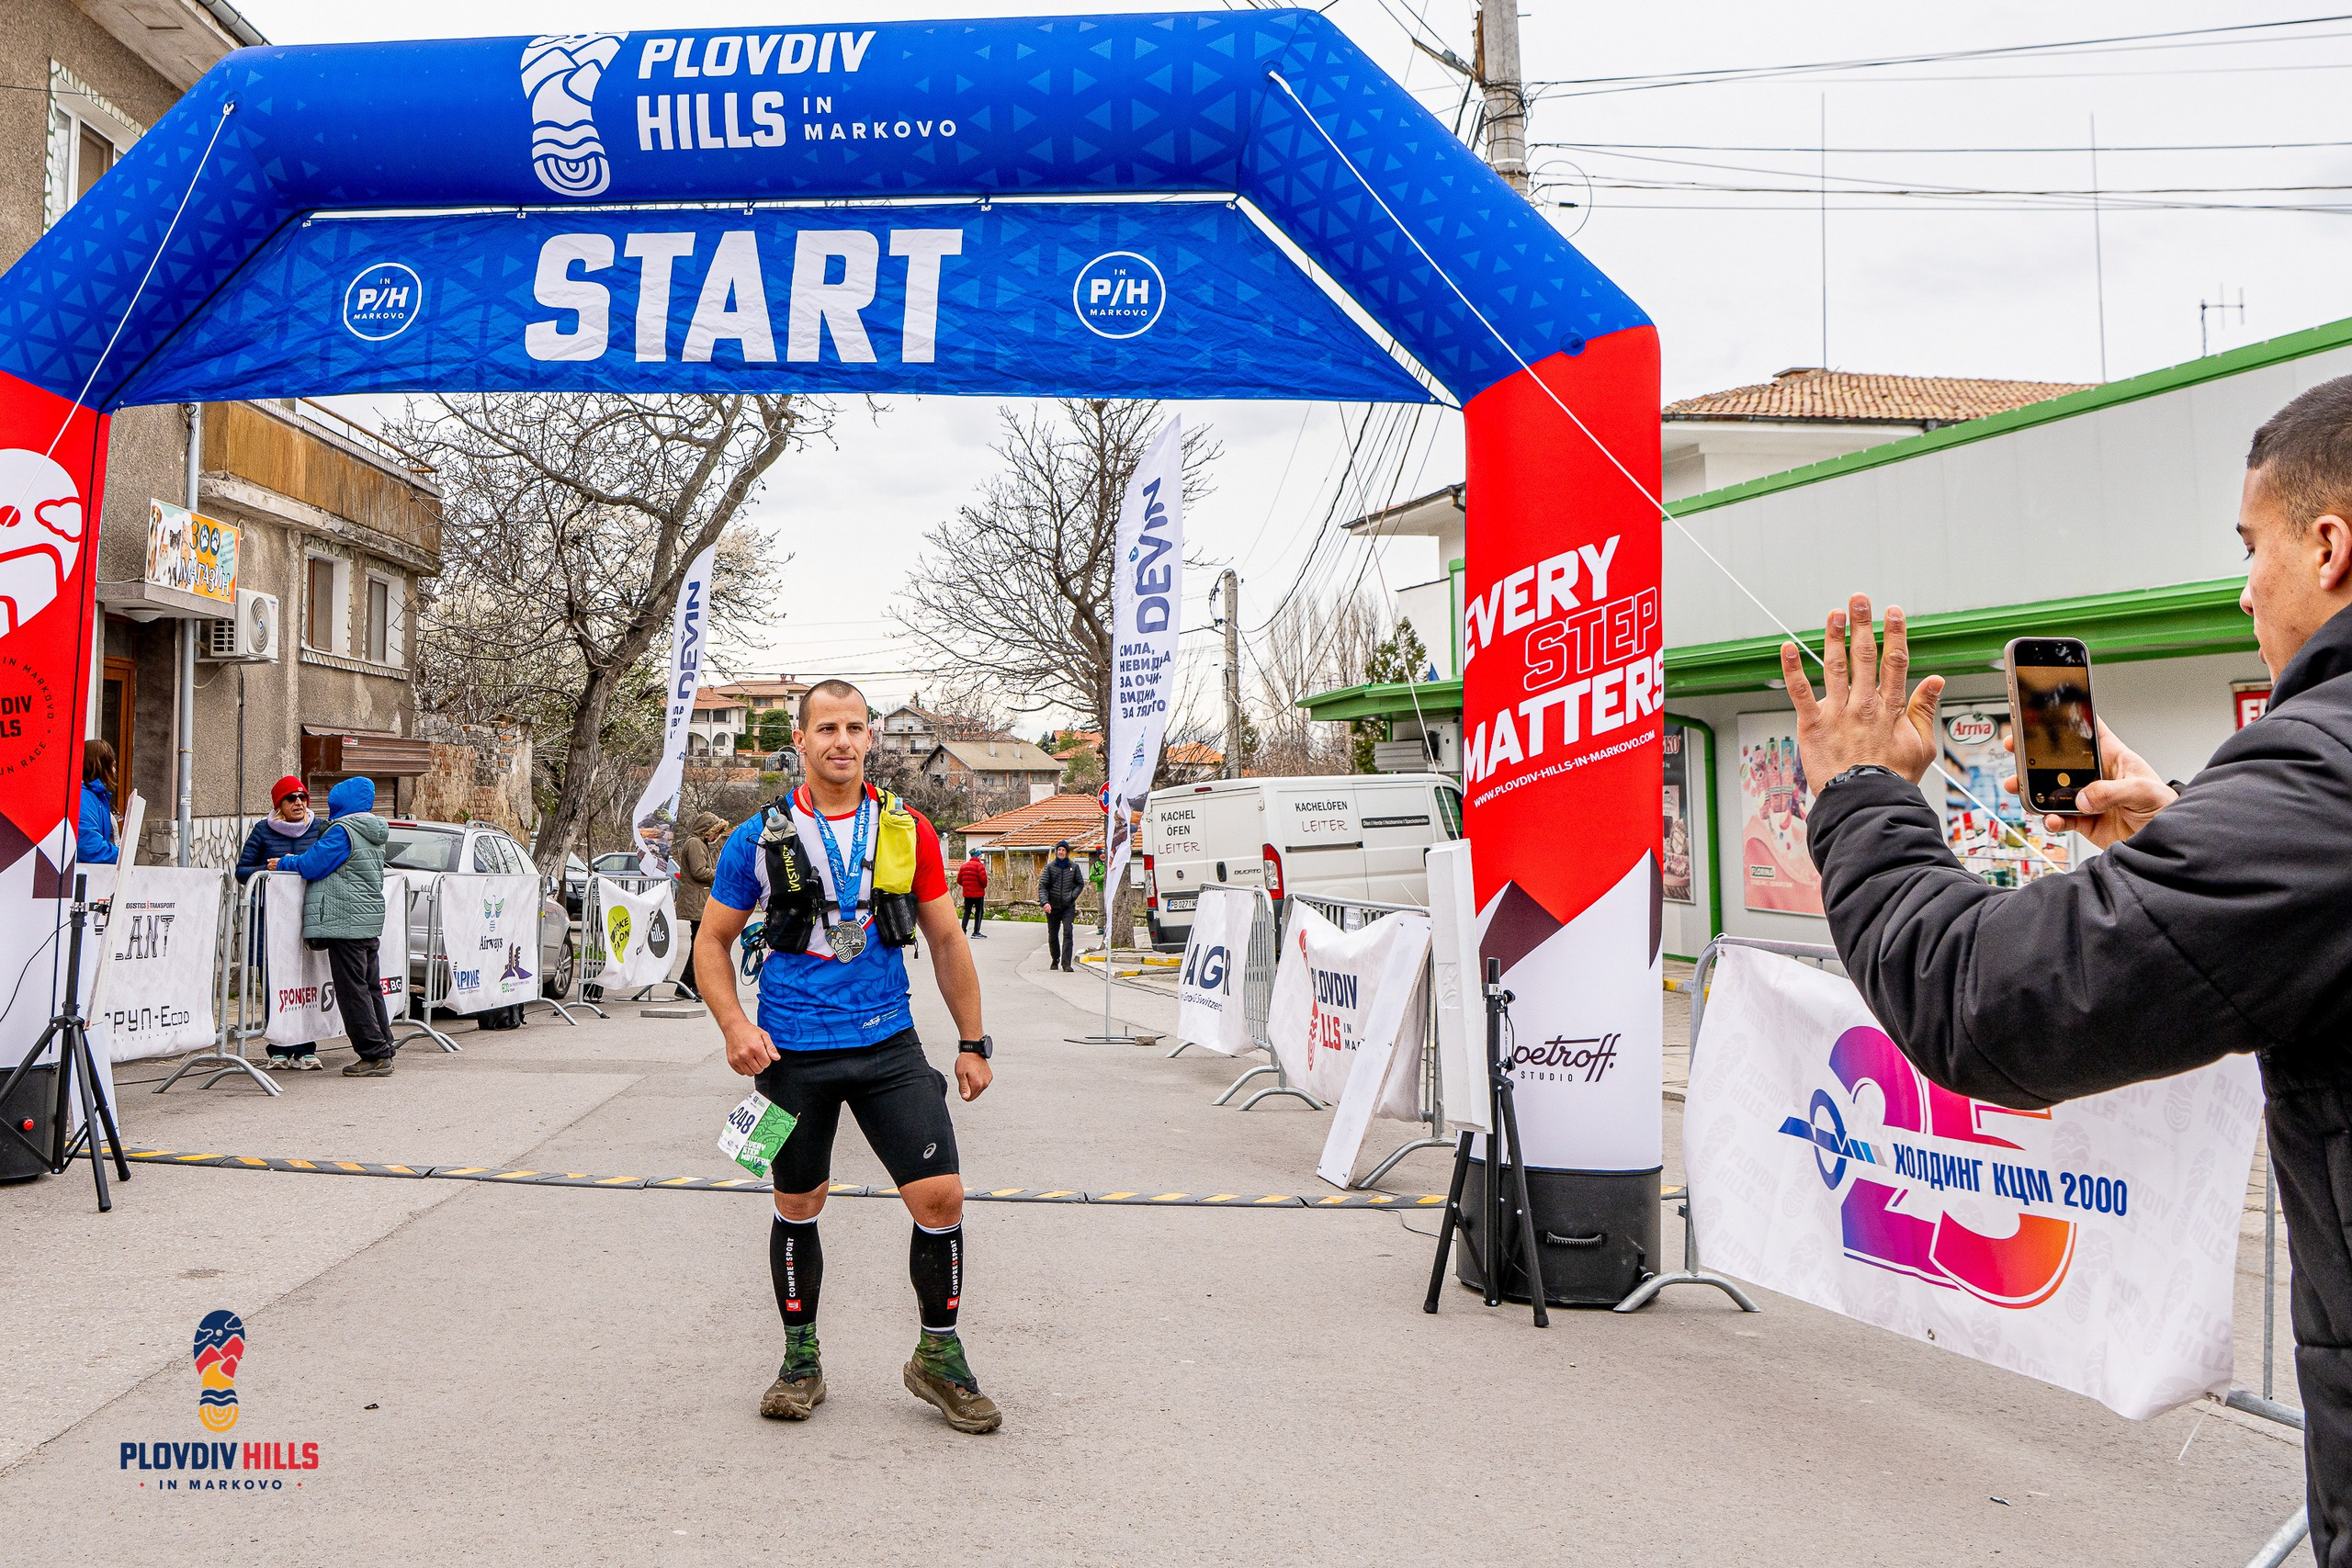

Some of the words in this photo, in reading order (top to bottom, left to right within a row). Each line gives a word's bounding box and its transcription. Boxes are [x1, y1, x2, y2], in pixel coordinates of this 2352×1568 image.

[638, 30, 876, 80] PLOVDIV
[637, 90, 786, 152] HILLS
[802, 96, 831, 115] IN
[804, 119, 957, 141] MARKOVO
[356, 287, 410, 310] P/H
[525, 229, 964, 364] START
[1090, 278, 1149, 307] P/H
[180, 558, 231, 596] МАГАЗИН
[1135, 477, 1173, 634] DEVIN
[1464, 535, 1621, 671] EVERY
[677, 581, 700, 699] DEVIN
[1523, 586, 1657, 692] STEP
[3, 656, 17, 666] IN
[23, 664, 54, 719] MARKOVO
[1463, 646, 1664, 799] MATTERS
[20, 741, 46, 768] RACE
[1474, 728, 1656, 808] WWW.PLOVDIV-HILLS-IN-MARKOVO.COM
[1160, 809, 1196, 822] KACHEL
[1302, 819, 1348, 833] LEITER
[1158, 841, 1201, 855] LEITER
[480, 936, 503, 952] Airways
[1521, 1070, 1573, 1082] STUDIO
[1892, 1142, 1983, 1195] ХОЛДИНГ
[1994, 1162, 2053, 1208] КЦМ
[2062, 1174, 2129, 1217] 2000
[786, 1237, 797, 1298] COMPRESSPORT
[950, 1239, 958, 1295] COMPRESSPORT
